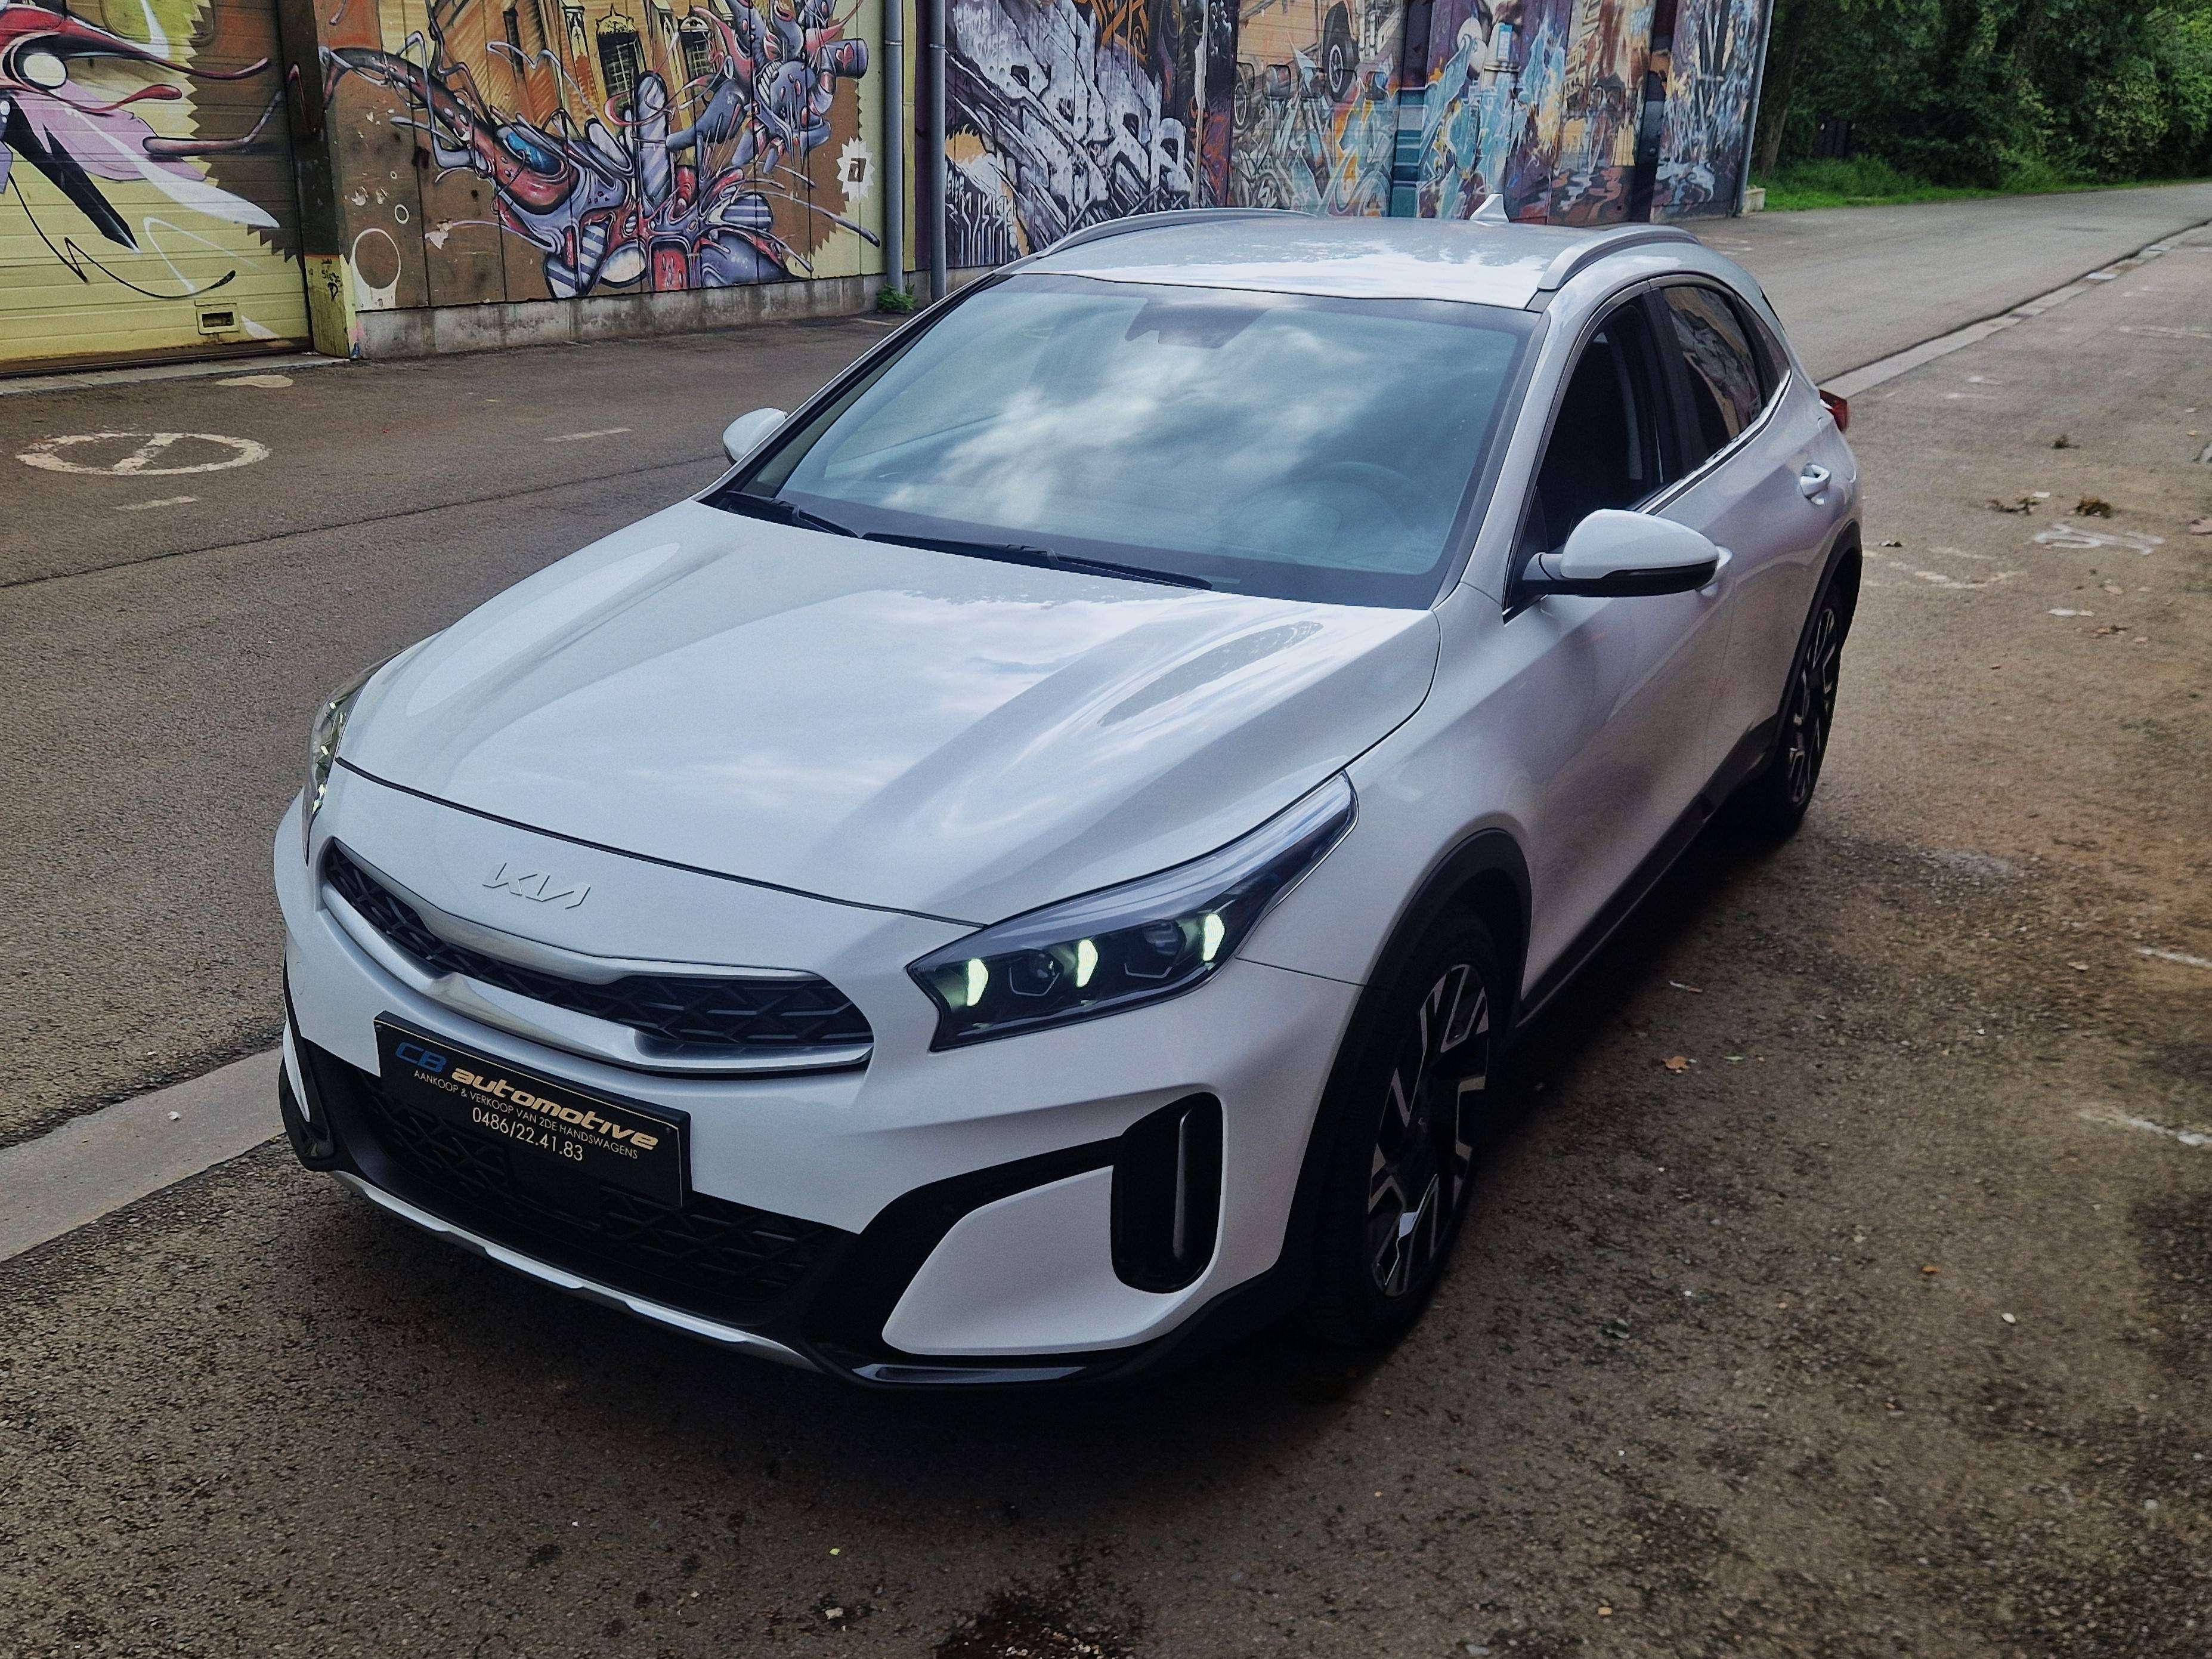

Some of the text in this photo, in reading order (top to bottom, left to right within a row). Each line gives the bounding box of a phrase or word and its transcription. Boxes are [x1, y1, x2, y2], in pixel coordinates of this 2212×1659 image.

[395, 1042, 658, 1150] CB automotive
[414, 1070, 638, 1160] AANKOOP & VERKOOP VAN 2DE HANDSWAGENS
[472, 1107, 584, 1161] 0486/22.41.83
